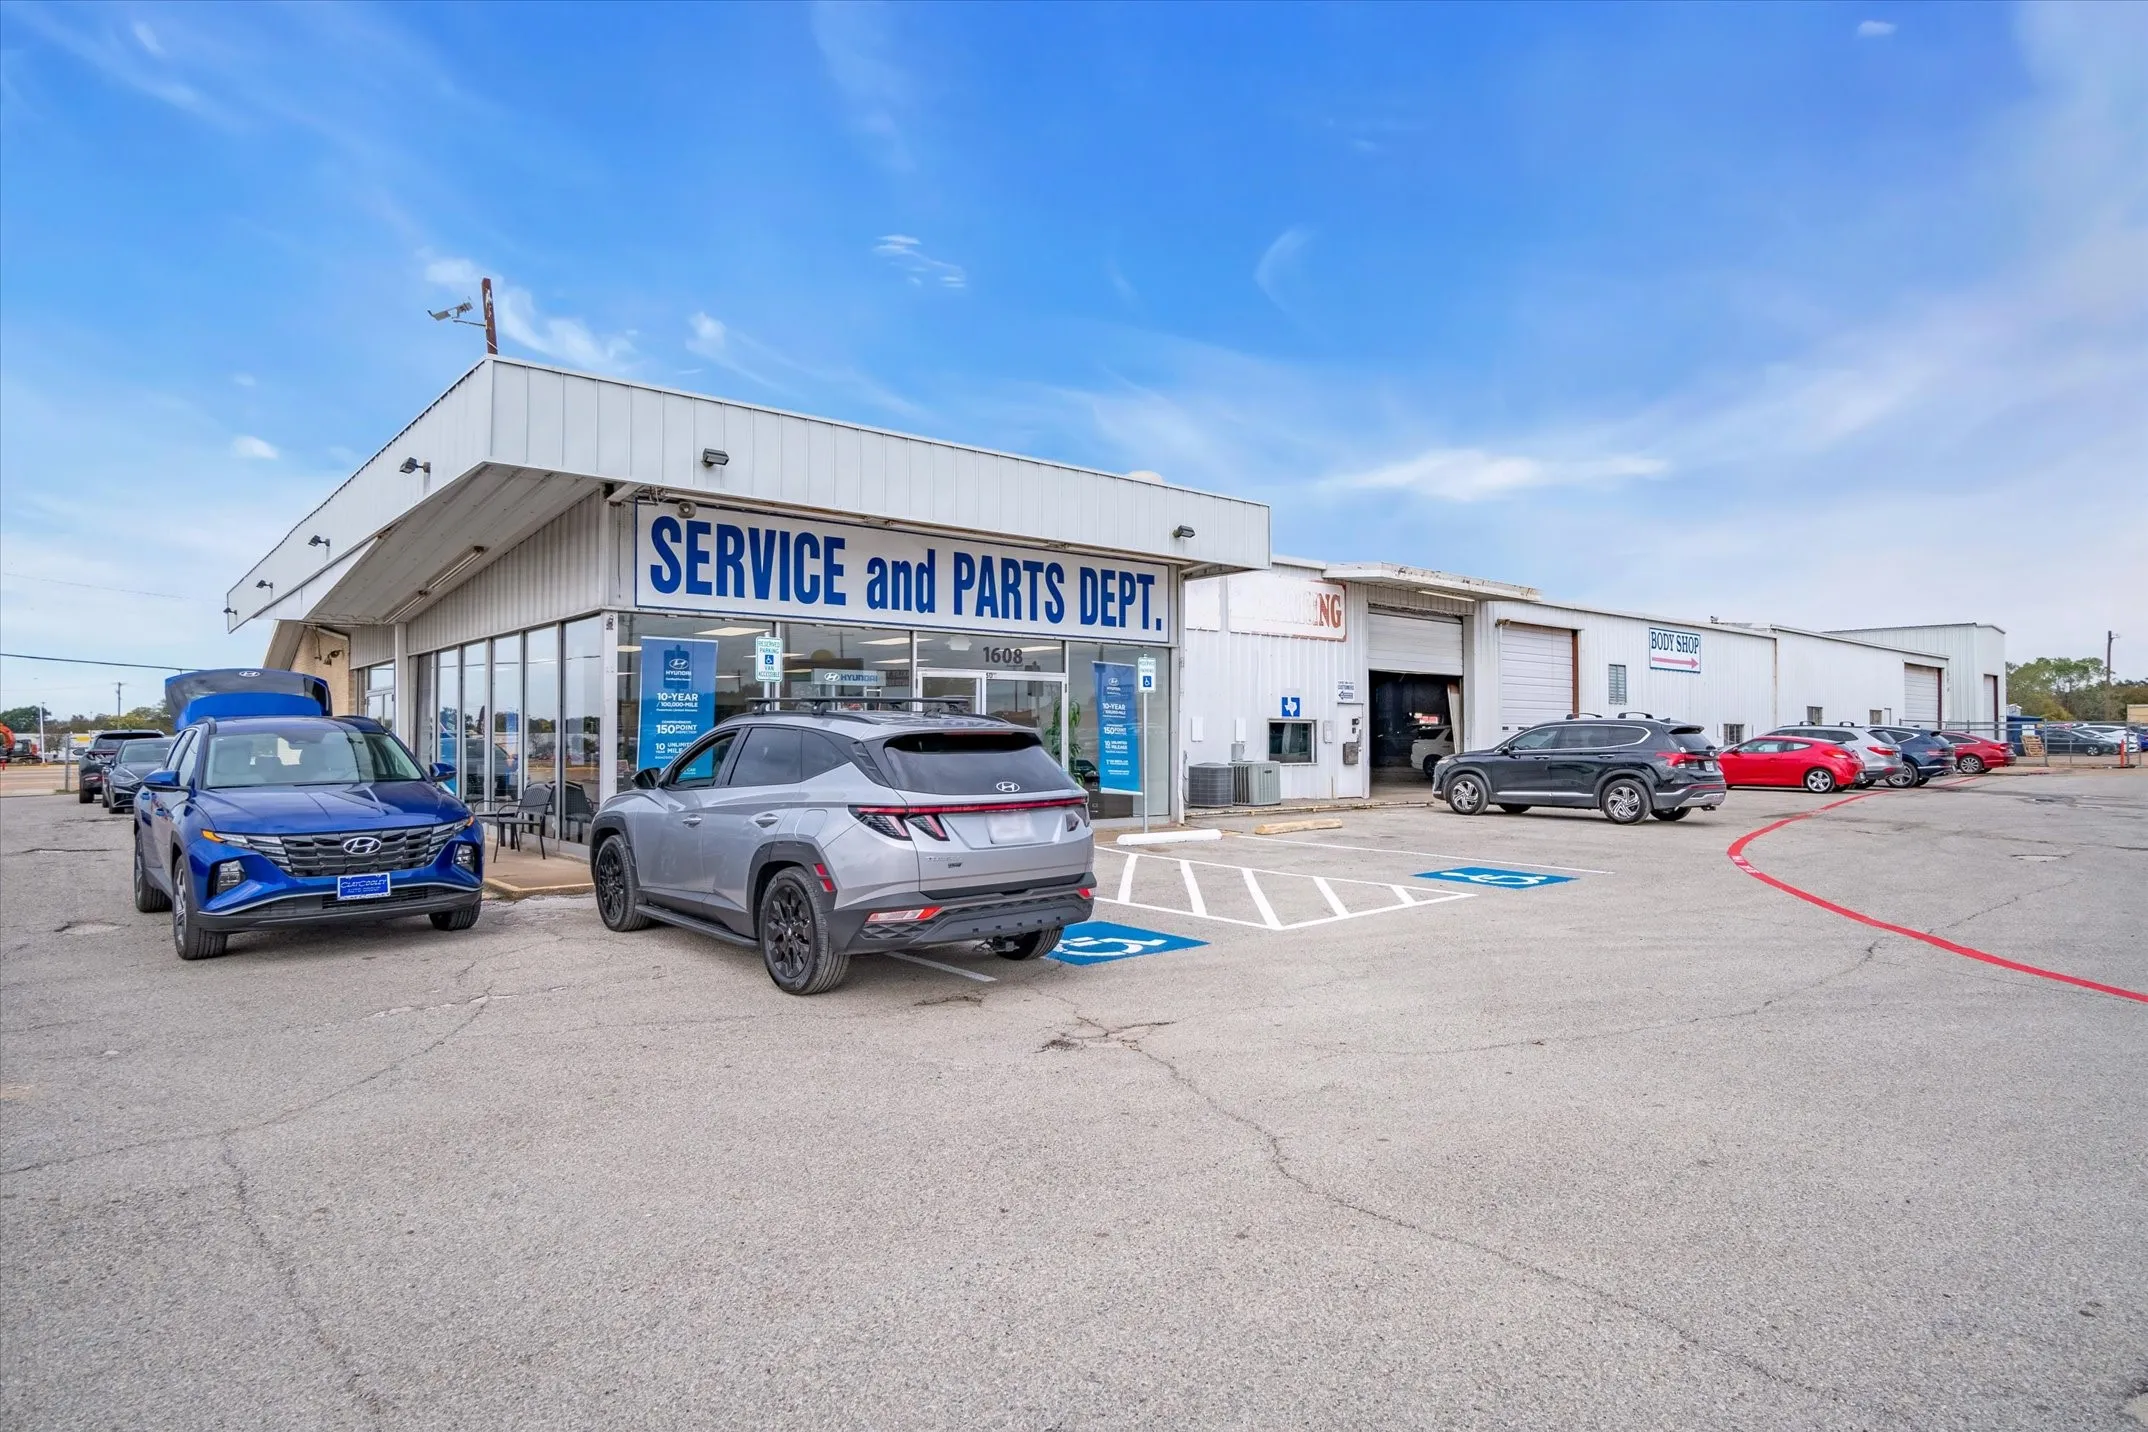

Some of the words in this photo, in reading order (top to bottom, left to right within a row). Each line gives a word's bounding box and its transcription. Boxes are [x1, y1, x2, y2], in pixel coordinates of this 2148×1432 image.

[650, 515, 846, 606] SERVICE
[866, 548, 936, 614] and
[953, 551, 1065, 624] PARTS
[1079, 566, 1162, 631] DEPT.
[758, 640, 781, 648] RESERVED
[1651, 631, 1674, 651] BODY
[1676, 635, 1699, 654] SHOP
[983, 646, 1023, 665] 1608
[840, 674, 878, 682] HYUNDAI
[657, 693, 698, 701] 10-YEAR
[1102, 703, 1126, 711] 10-YEAR
[655, 724, 676, 734] 150
[1103, 726, 1115, 735] 150
[655, 742, 666, 750] 10
